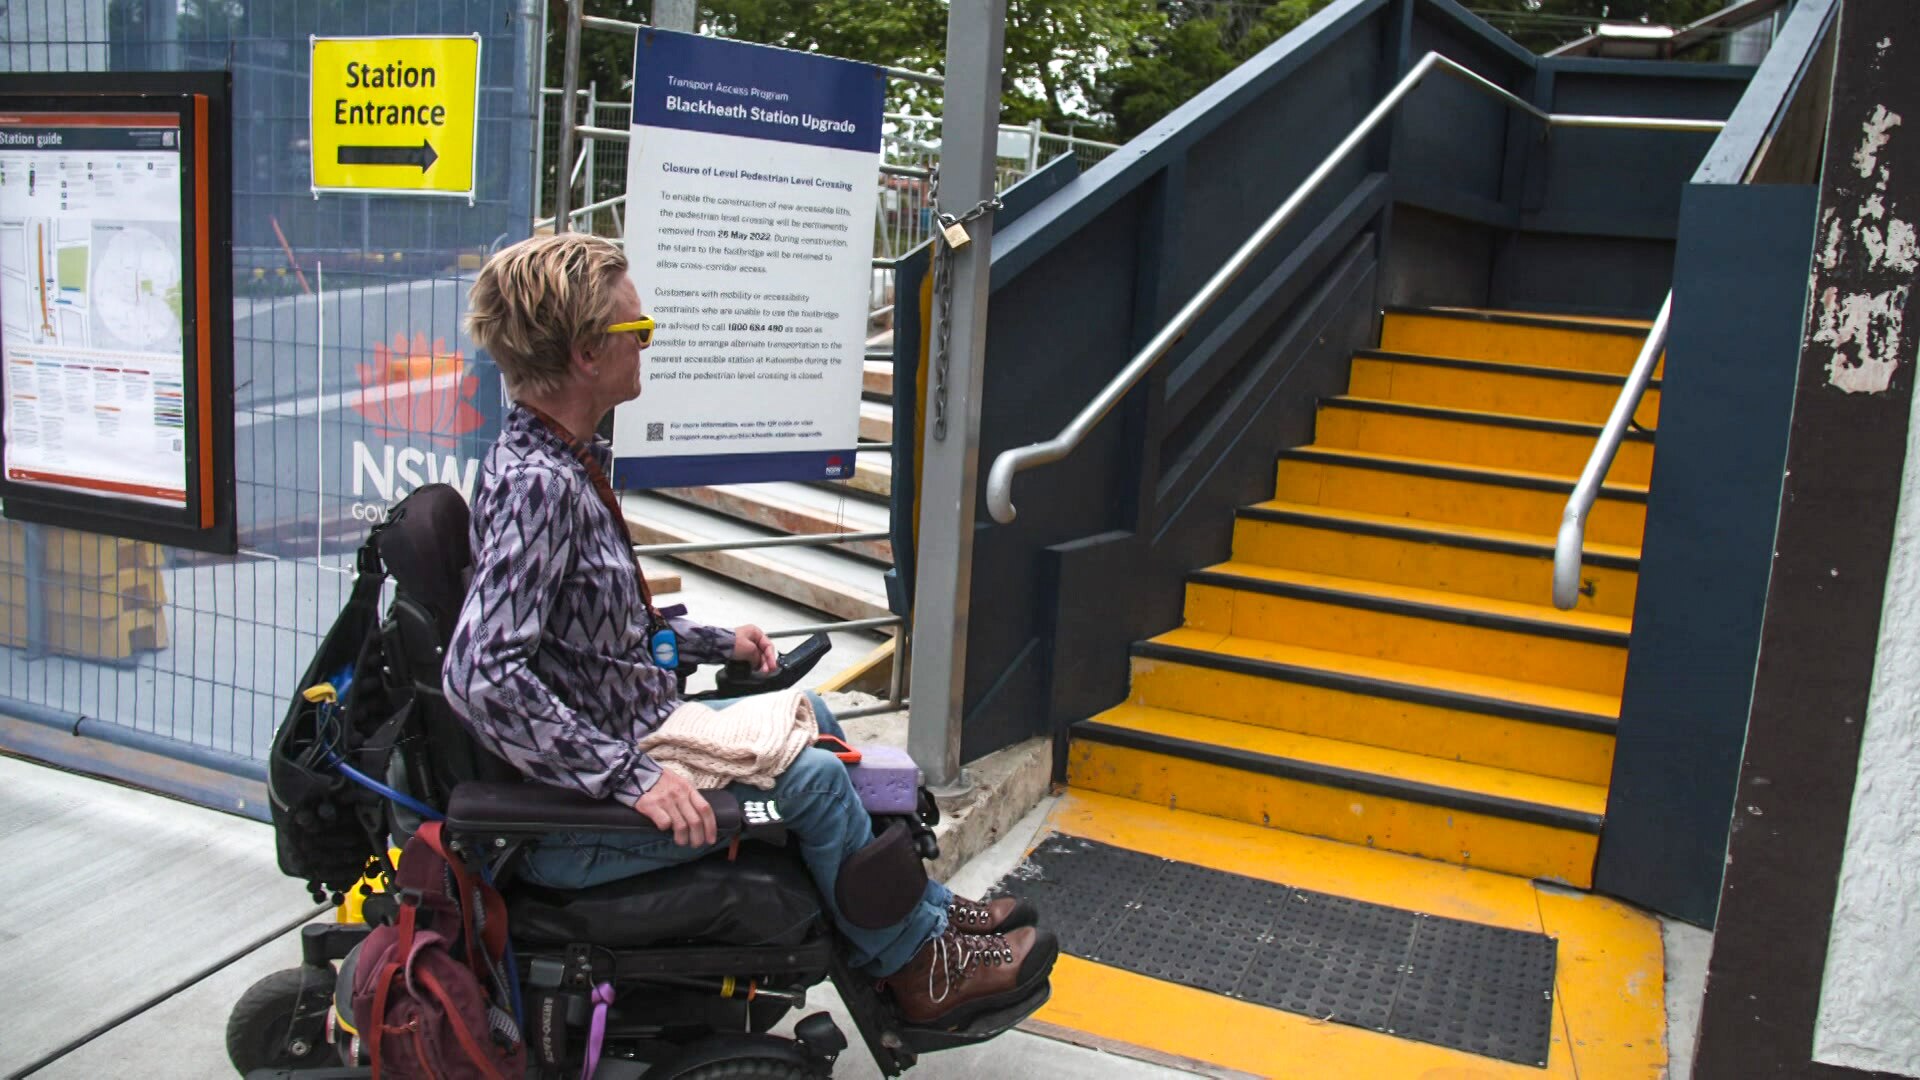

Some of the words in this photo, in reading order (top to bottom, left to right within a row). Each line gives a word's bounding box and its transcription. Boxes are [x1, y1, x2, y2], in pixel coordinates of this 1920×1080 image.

[346, 60, 436, 88] Station
[668, 75, 714, 91] Transport
[716, 82, 749, 96] Access
[751, 88, 789, 102] Program
[335, 98, 446, 126] Entrance
[666, 95, 747, 119] Blackheath
[750, 106, 799, 126] Station
[802, 114, 856, 134] Upgrade
[0, 131, 35, 145] Station
[37, 132, 63, 148] guide
[662, 162, 700, 175] Closure
[702, 166, 712, 176] of
[714, 168, 738, 179] Level
[740, 170, 789, 184] Pedestrian
[791, 176, 814, 187] Level
[815, 178, 853, 192] Crossing
[661, 190, 671, 200] To
[672, 193, 700, 203] enable
[702, 195, 716, 204] the
[717, 198, 767, 209] construction
[768, 200, 777, 209] of
[778, 203, 794, 211] new
[795, 205, 835, 215] accessible
[659, 208, 674, 217] the
[675, 210, 720, 221] pedestrian
[721, 213, 740, 223] level
[741, 216, 775, 227] crossing
[776, 218, 790, 227] will
[791, 219, 801, 228] be
[802, 221, 849, 233] permanently
[658, 227, 695, 237] removed
[696, 228, 716, 238] from
[730, 230, 748, 241] May
[774, 233, 800, 245] During
[657, 243, 672, 252] the
[673, 244, 697, 253] stairs
[698, 245, 707, 254] to
[708, 246, 722, 255] the
[723, 247, 765, 259] footbridge
[766, 249, 780, 259] will
[781, 250, 791, 259] be
[792, 252, 824, 261] retained
[825, 253, 833, 262] to
[656, 260, 678, 269] allow
[680, 261, 737, 272] cross-corridor
[654, 286, 700, 297] Customers
[701, 290, 719, 299] with
[720, 291, 752, 301] mobility
[763, 292, 810, 302] accessibility
[653, 305, 700, 314] constraints
[701, 306, 718, 315] who
[734, 307, 761, 316] unable
[762, 308, 770, 317] to
[787, 309, 800, 317] the
[801, 309, 840, 320] footbridge
[654, 322, 666, 330] are
[668, 321, 700, 330] advised
[702, 322, 710, 331] to
[711, 322, 726, 331] call
[652, 339, 686, 349] possible
[688, 339, 696, 348] to
[698, 340, 729, 349] arrange
[730, 339, 766, 348] alternate
[767, 341, 820, 350] transportation
[821, 341, 829, 350] to
[830, 341, 843, 350] the
[651, 355, 682, 364] nearest
[684, 355, 726, 364] accessible
[728, 355, 755, 364] station
[756, 356, 763, 364] at
[765, 356, 804, 365] Katoomba
[804, 356, 828, 366] during
[830, 356, 842, 365] the
[650, 371, 677, 381] period
[678, 371, 692, 379] the
[693, 371, 736, 381] pedestrian
[737, 371, 756, 380] level
[757, 372, 789, 381] crossing
[790, 371, 797, 380] is
[670, 421, 680, 429] For
[353, 440, 480, 507] NSW
